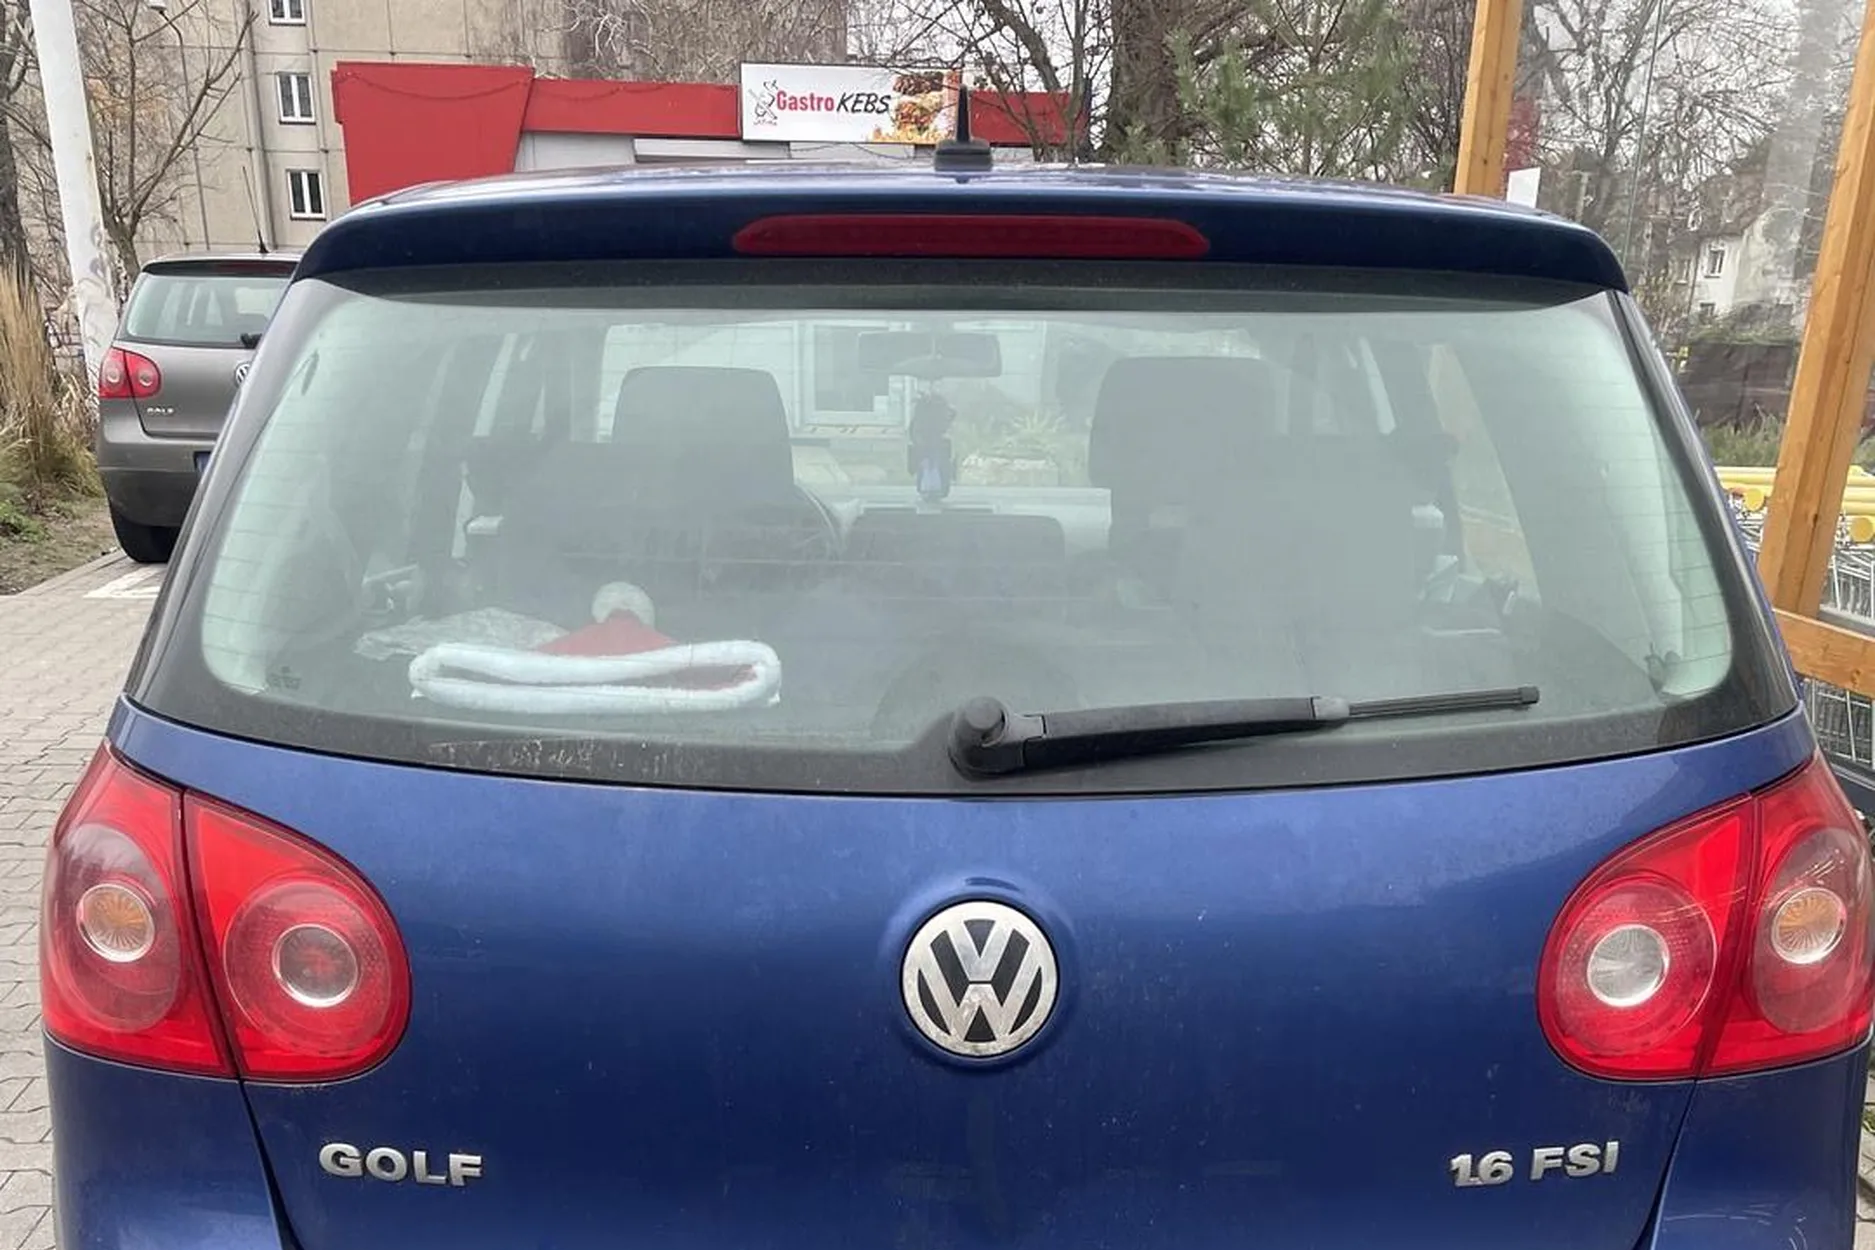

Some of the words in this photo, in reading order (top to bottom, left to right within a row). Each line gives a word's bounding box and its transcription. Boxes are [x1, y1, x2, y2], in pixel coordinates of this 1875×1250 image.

[776, 90, 834, 112] Gastro
[836, 92, 891, 114] KEBS
[319, 1142, 482, 1186] GOLF
[1529, 1140, 1619, 1181] FSI
